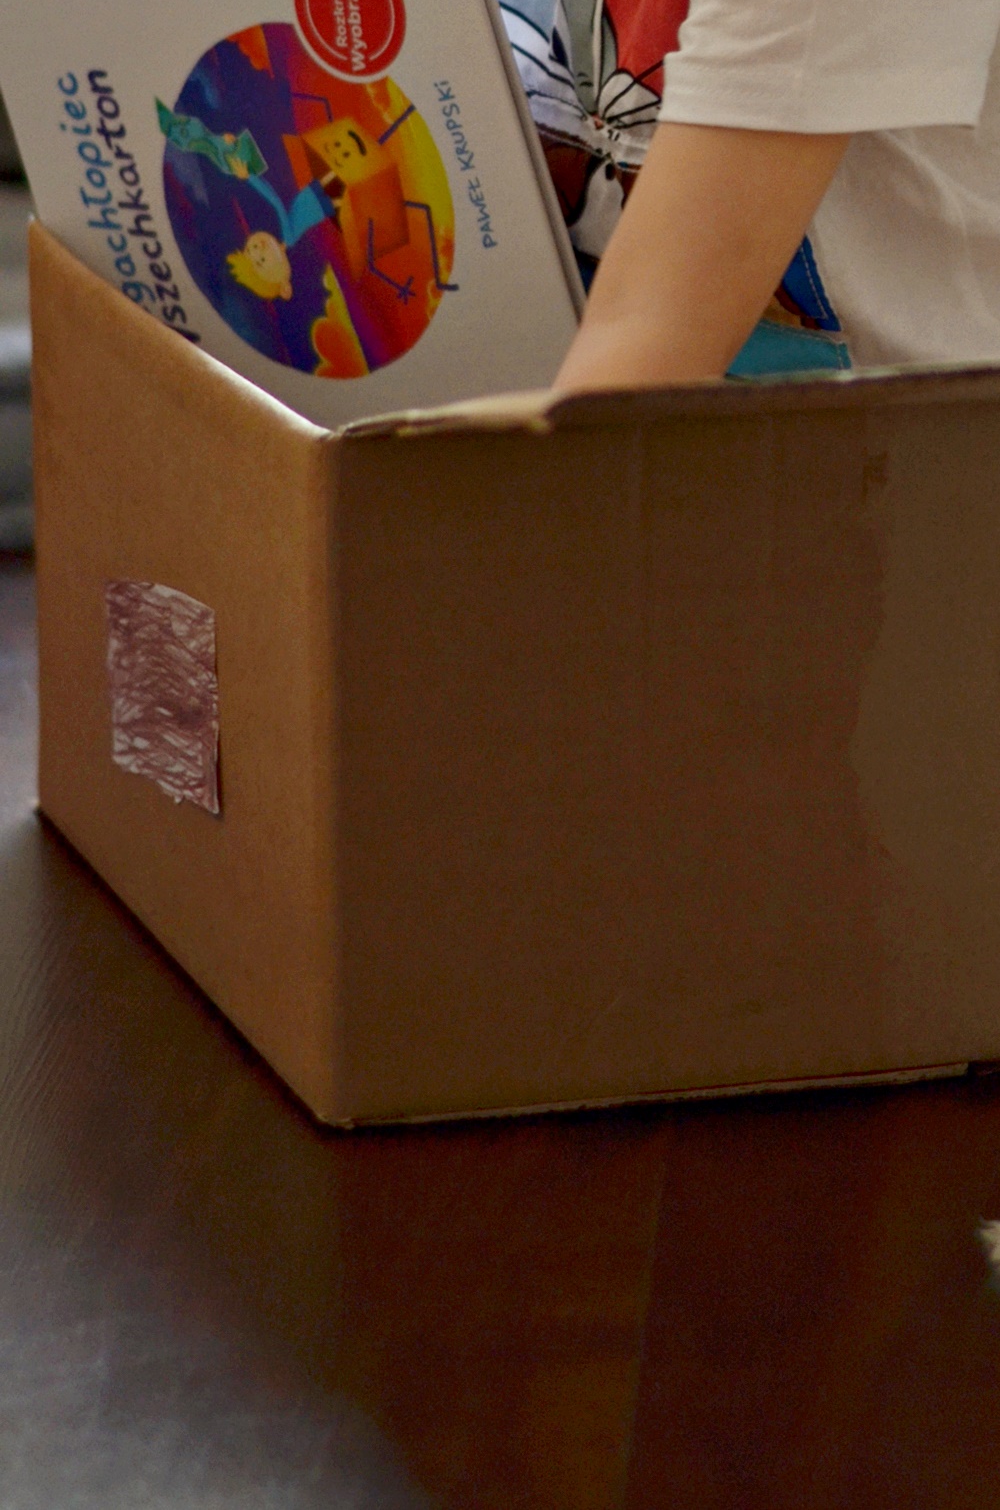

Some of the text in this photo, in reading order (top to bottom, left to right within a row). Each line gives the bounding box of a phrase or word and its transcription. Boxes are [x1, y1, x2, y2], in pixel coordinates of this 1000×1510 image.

[58, 71, 155, 312] gachłopiec
[88, 69, 201, 342] szechkarton
[468, 177, 498, 249] PAWEŁ
